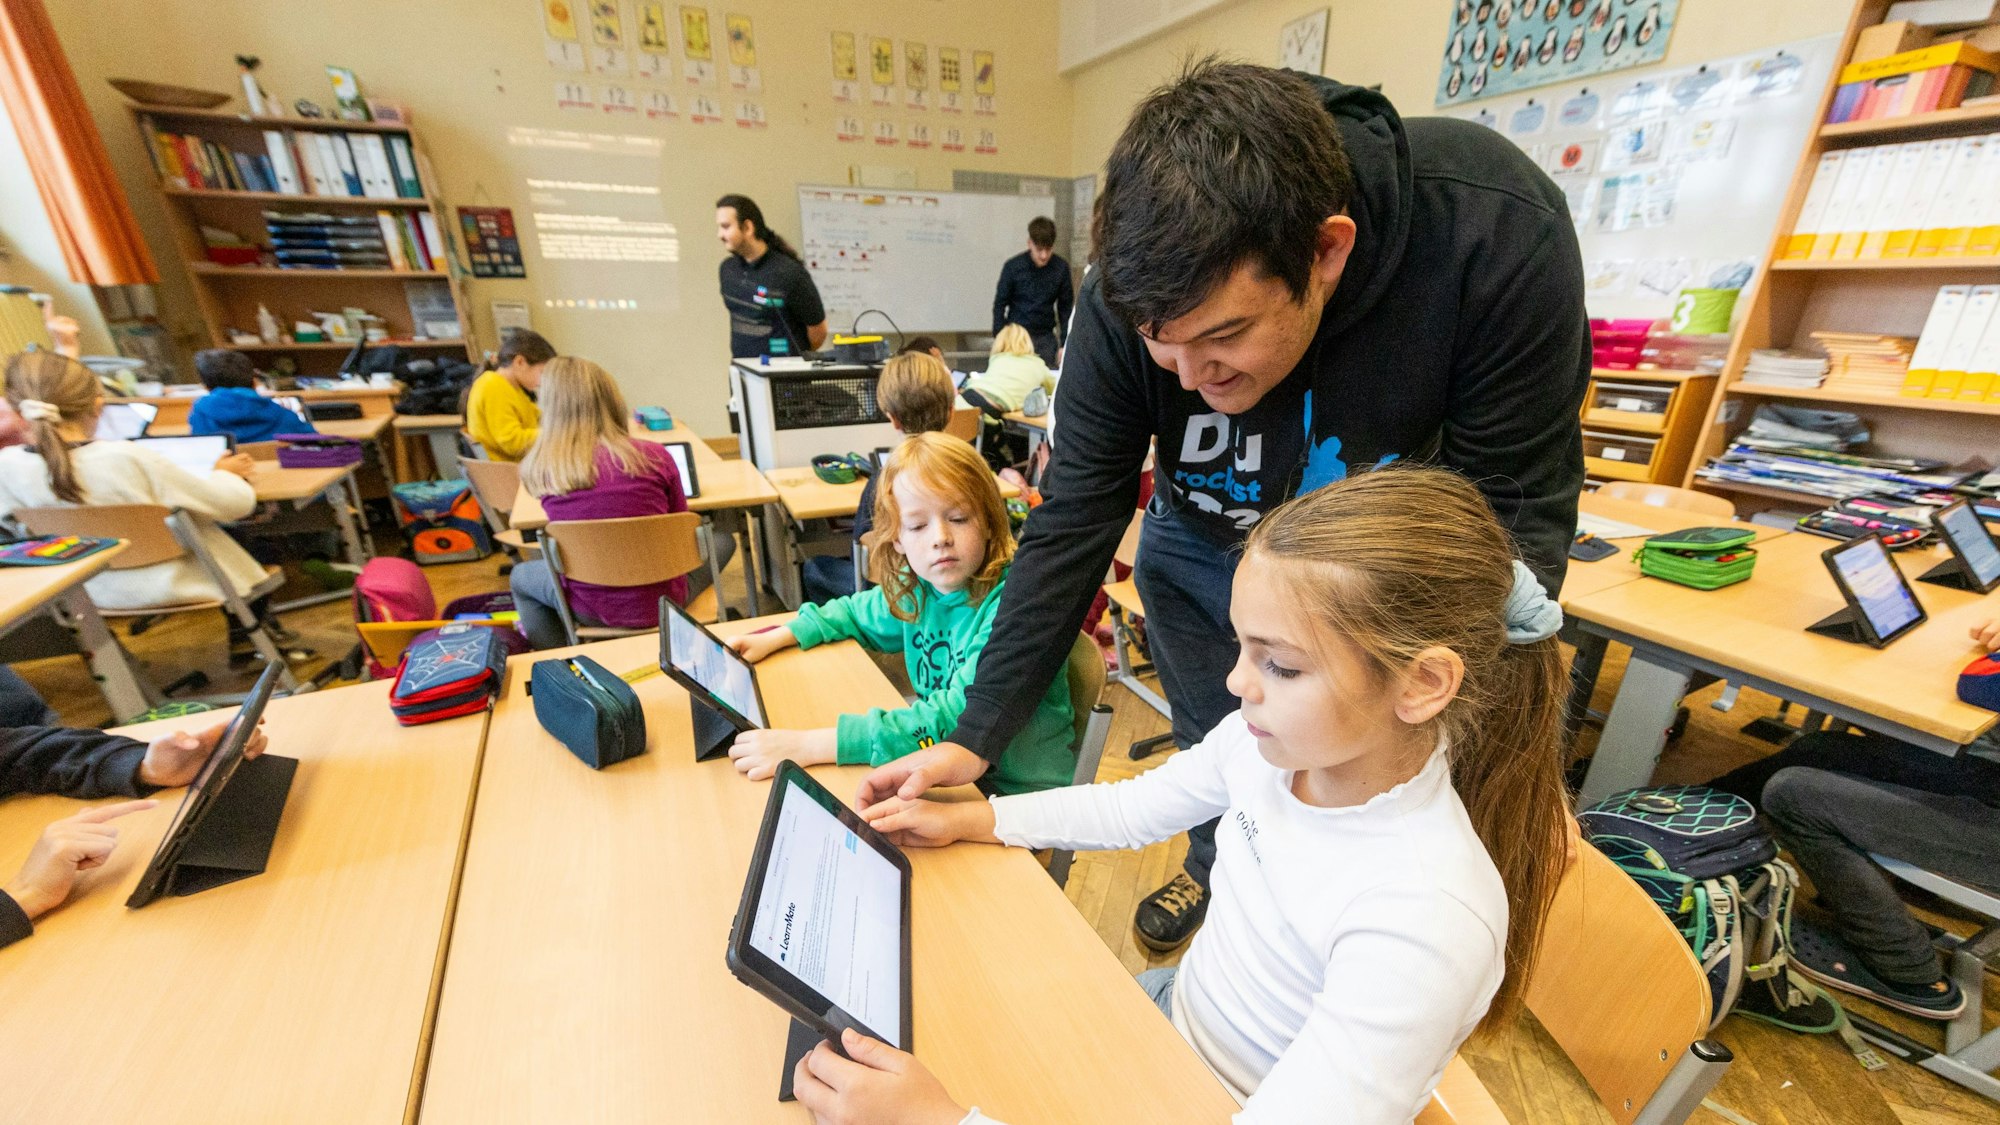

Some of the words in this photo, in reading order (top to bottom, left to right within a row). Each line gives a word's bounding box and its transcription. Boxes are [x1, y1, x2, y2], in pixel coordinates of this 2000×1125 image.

[565, 85, 583, 102] 11
[608, 87, 626, 104] 12
[653, 93, 670, 110] 13
[843, 118, 858, 132] 16
[880, 122, 893, 136] 17
[948, 129, 960, 143] 19
[980, 130, 993, 145] 20
[1671, 294, 1695, 332] 3
[1179, 412, 1262, 472] Du
[779, 902, 796, 951] LearnMate
